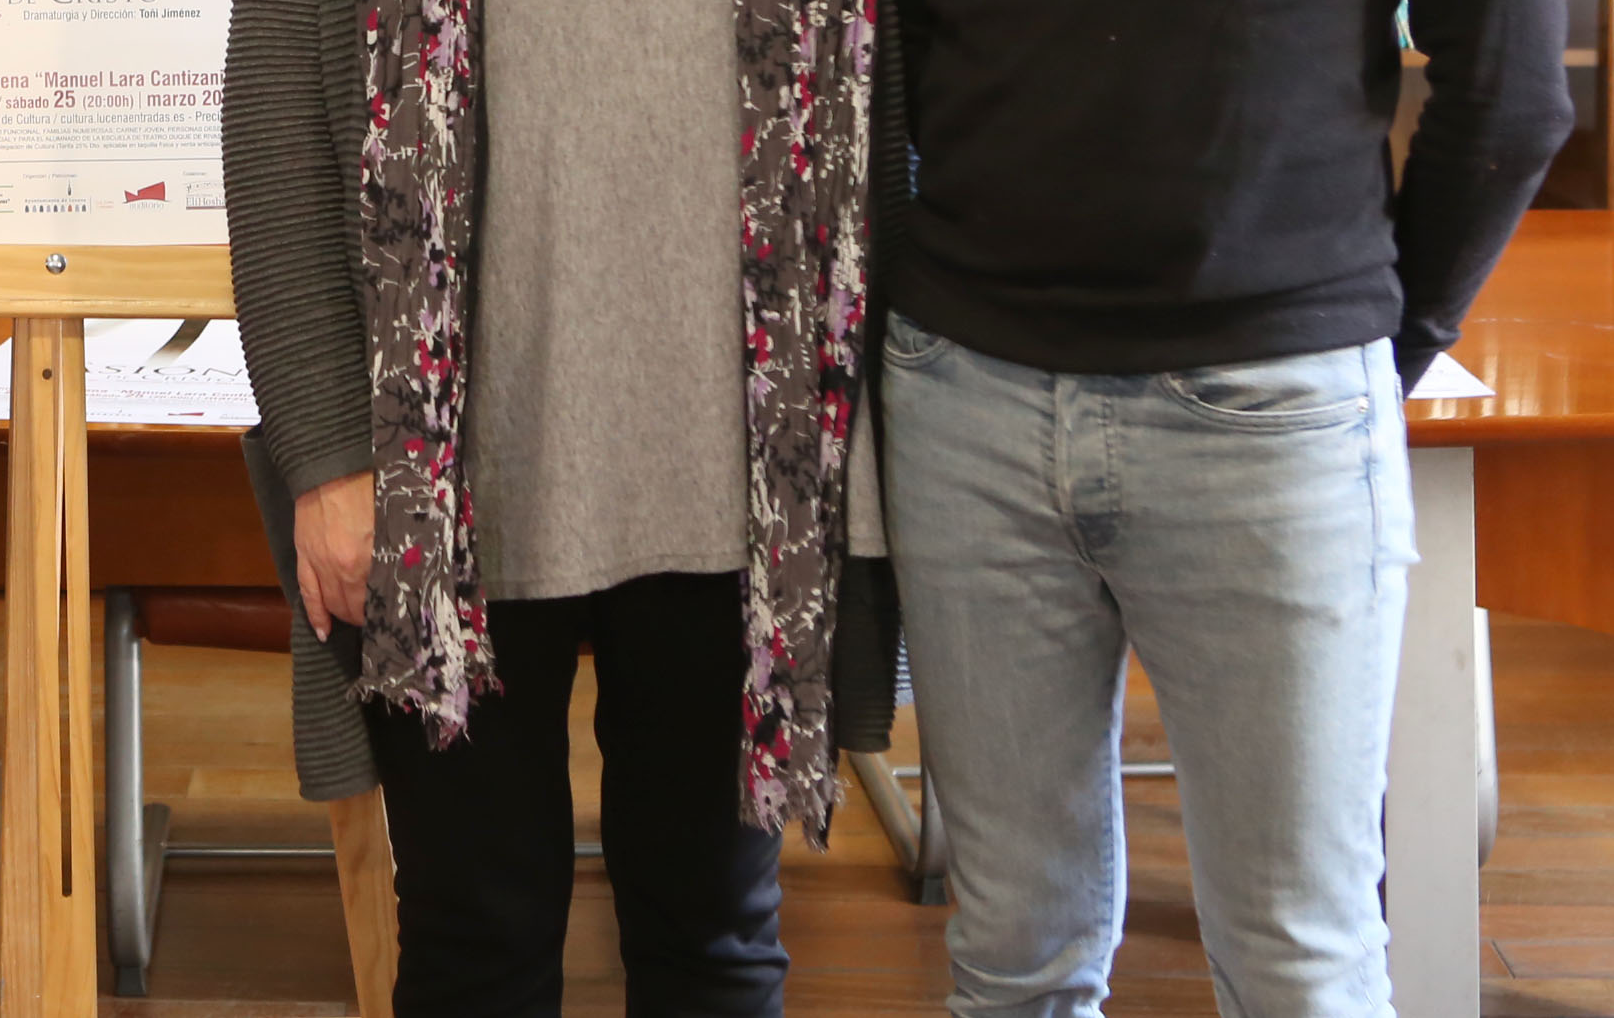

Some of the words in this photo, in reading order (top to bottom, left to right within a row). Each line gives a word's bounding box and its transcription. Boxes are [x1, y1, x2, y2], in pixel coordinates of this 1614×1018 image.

[22, 9, 79, 22] Dramaturgia
[82, 11, 88, 22] y
[90, 7, 137, 20] Dirección:
[139, 7, 159, 19] Toñi
[161, 7, 202, 19] Jiménez
[109, 71, 144, 87] Lara
[5, 94, 49, 109] sábado
[53, 90, 76, 108] 25
[82, 94, 134, 110] (20:00h)
[147, 93, 196, 107] marzo
[202, 89, 223, 106] 20
[2, 113, 13, 124] de
[16, 113, 51, 125] Cultura
[60, 111, 185, 124] cultura.lucenaentradas.es
[42, 127, 71, 135] FAMILIAS
[116, 126, 141, 134] CARNET
